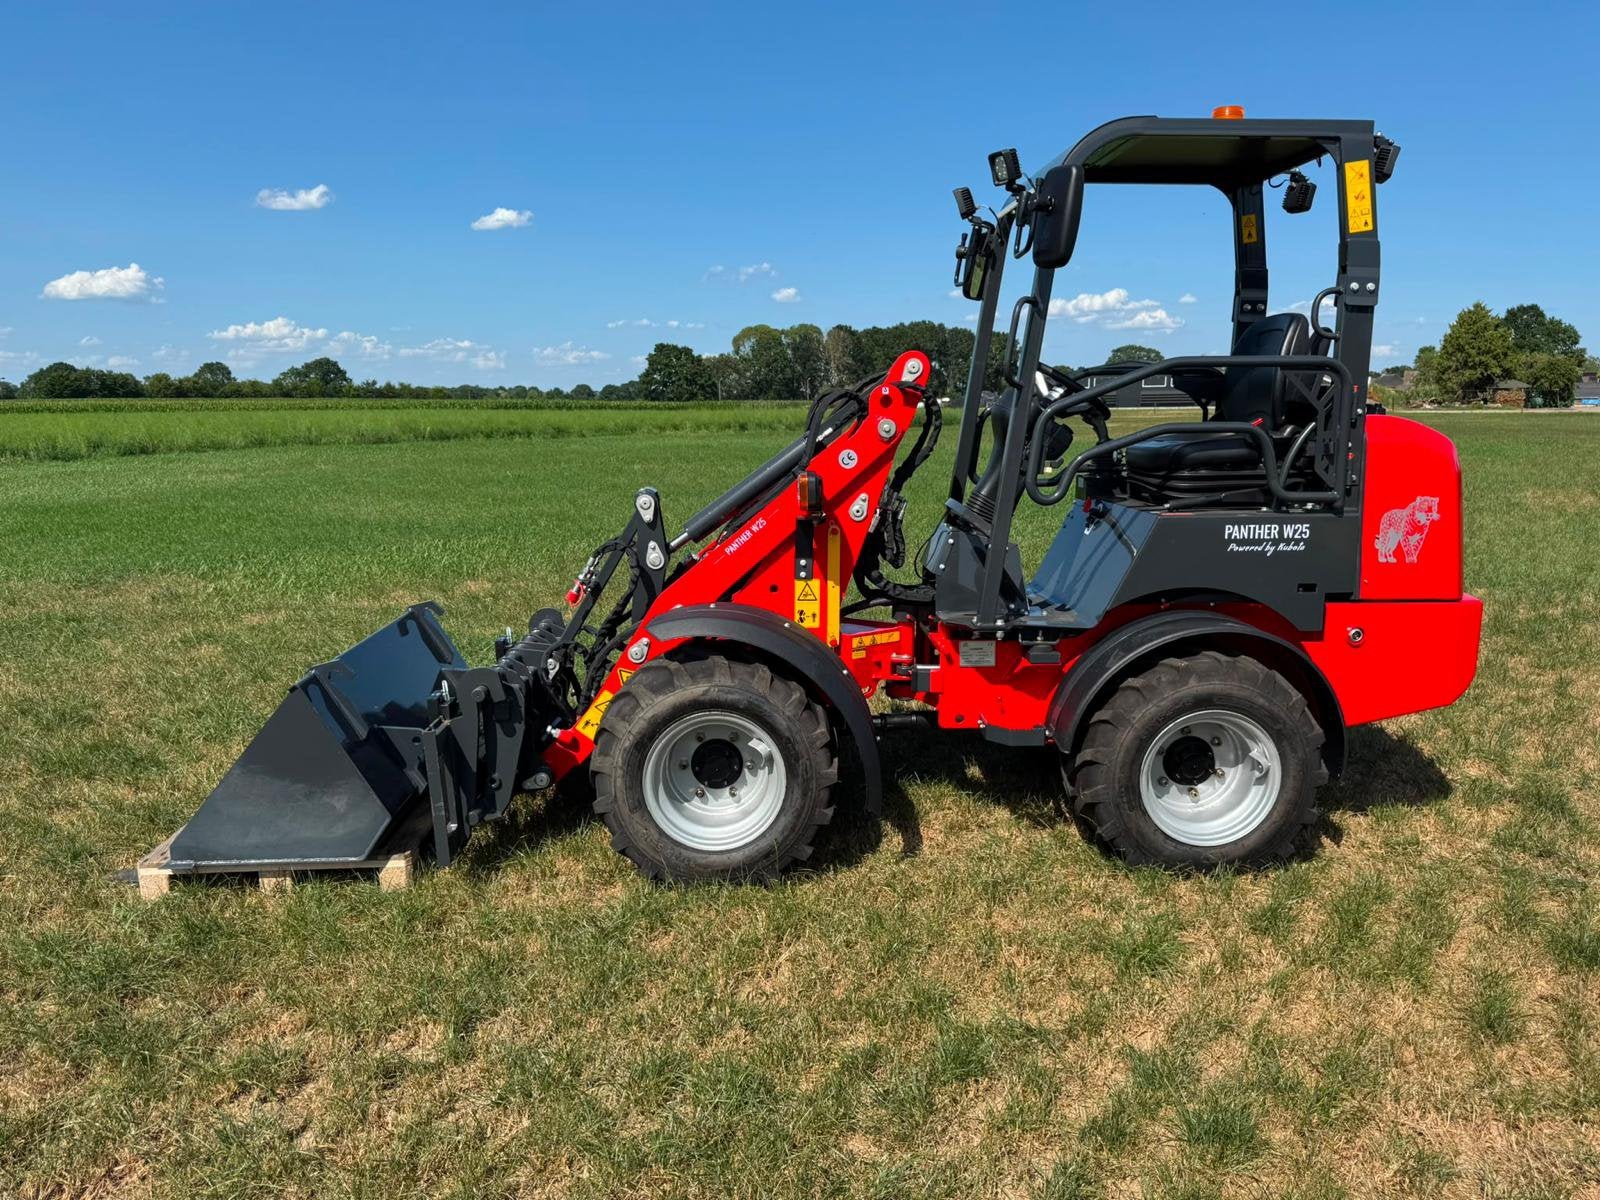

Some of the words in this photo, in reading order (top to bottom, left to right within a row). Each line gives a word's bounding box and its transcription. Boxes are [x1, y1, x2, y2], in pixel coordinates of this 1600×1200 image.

[841, 452, 856, 466] CE
[725, 530, 753, 556] PANTHER
[751, 517, 767, 533] W25
[1224, 524, 1279, 539] PANTHER
[1283, 524, 1310, 539] W25
[1227, 541, 1266, 551] Powered
[1264, 541, 1276, 557] by
[1277, 541, 1306, 551] Kubota
